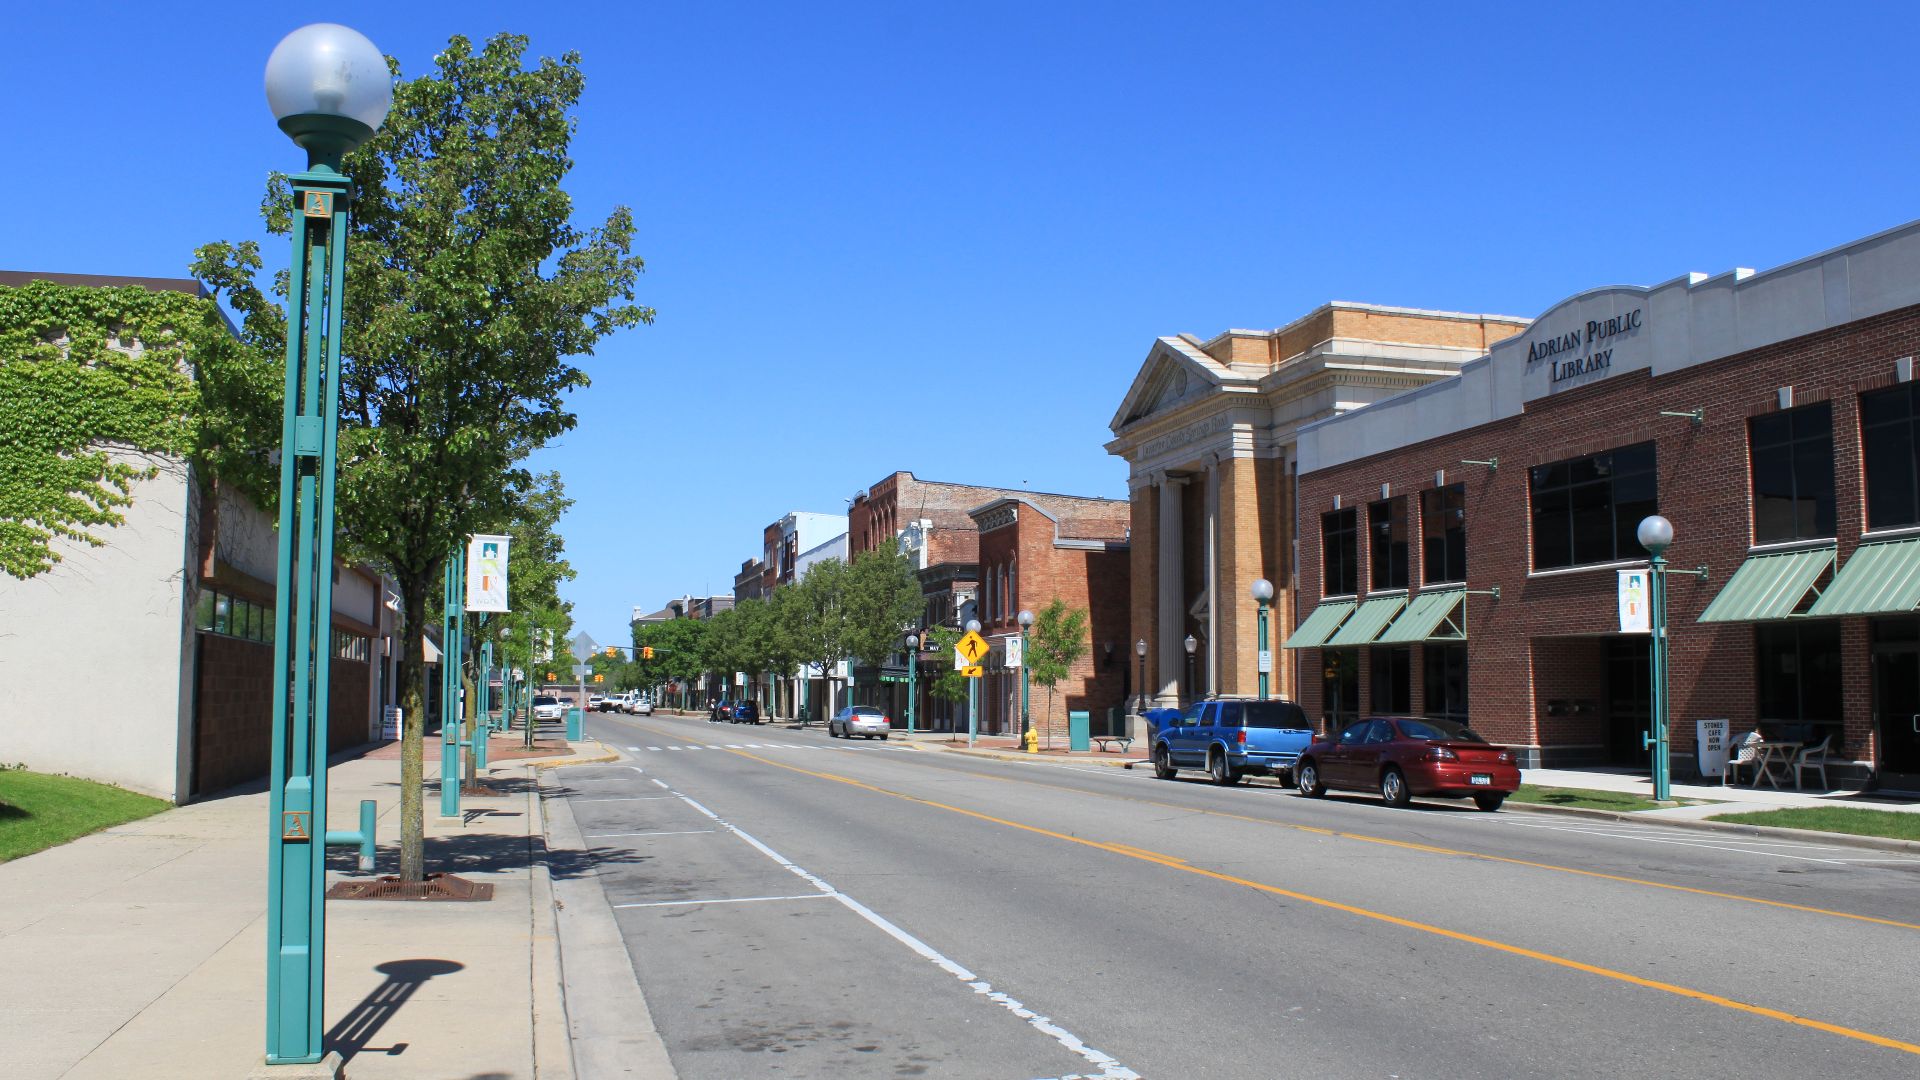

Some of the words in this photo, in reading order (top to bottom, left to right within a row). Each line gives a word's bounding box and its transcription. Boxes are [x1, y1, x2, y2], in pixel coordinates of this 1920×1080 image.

[1527, 329, 1581, 363] ADRIAN
[1586, 309, 1641, 343] PUBLIC
[1552, 348, 1613, 383] LIBRARY
[1707, 744, 1721, 752] OPEN
